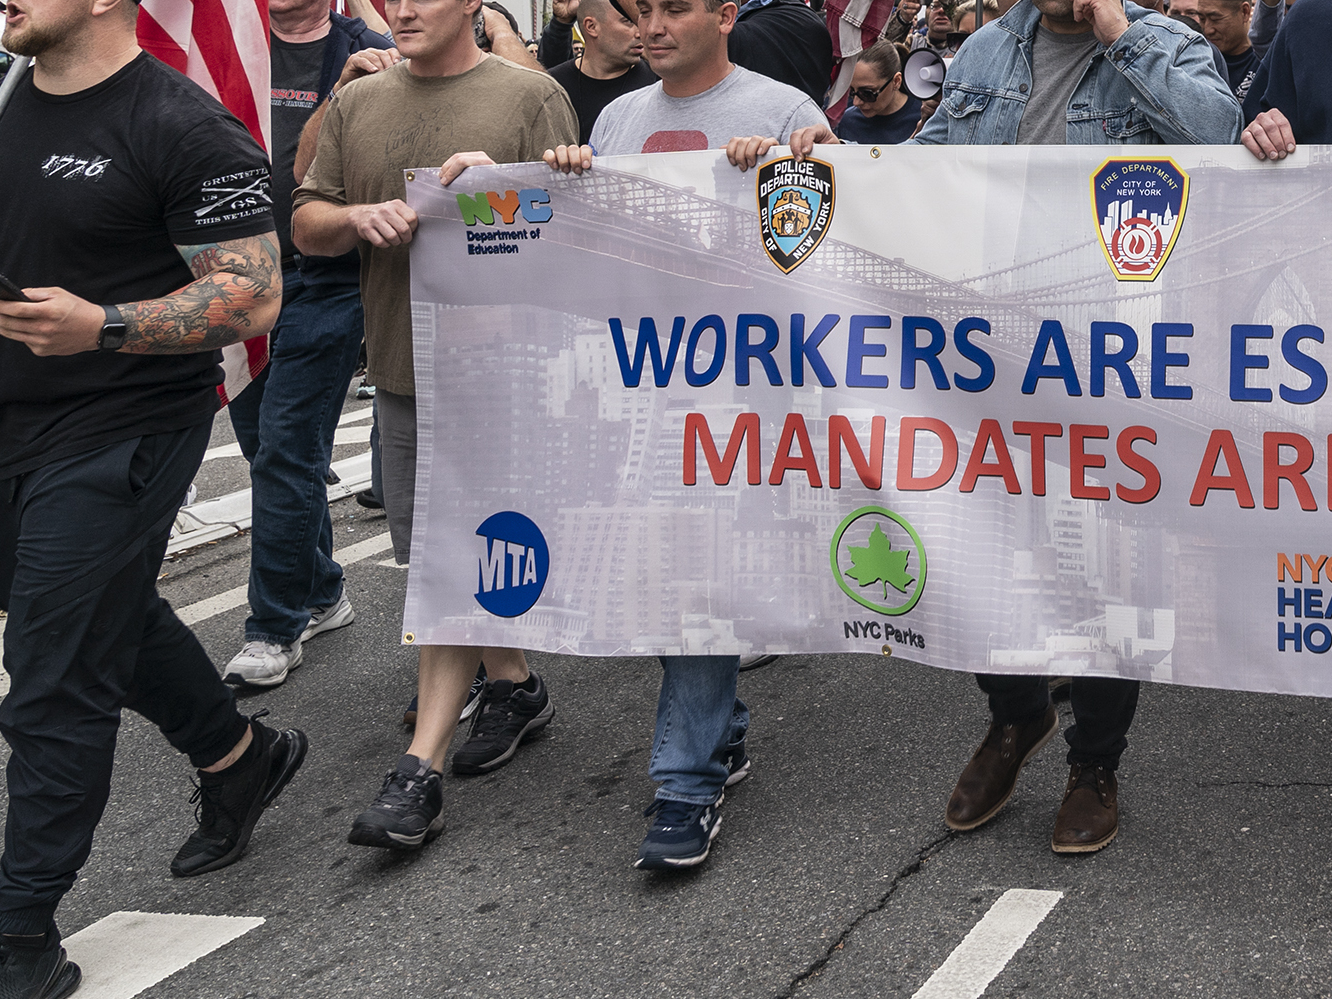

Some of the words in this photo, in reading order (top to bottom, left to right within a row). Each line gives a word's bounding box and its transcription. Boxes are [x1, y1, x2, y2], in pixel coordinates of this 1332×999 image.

[42, 155, 112, 180] 1776
[774, 160, 815, 176] POLICE
[1100, 171, 1119, 191] FIRE
[1121, 163, 1178, 190] DEPARTMENT
[760, 174, 831, 198] DEPARTMENT
[1122, 180, 1142, 188] CITY
[1145, 180, 1157, 188] OF
[202, 194, 218, 202] US
[231, 196, 257, 210] GS
[456, 188, 553, 226] NYC
[195, 216, 221, 226] THIS
[222, 210, 251, 221] WE'LL
[466, 229, 528, 244] Department
[530, 228, 541, 240] of
[761, 207, 769, 235] CITY
[765, 237, 778, 251] OF
[792, 235, 815, 260] NEW
[813, 201, 831, 232] YORK
[467, 242, 519, 255] Education
[607, 312, 996, 393] WORKERS
[1021, 319, 1194, 400] ARE
[682, 412, 1162, 505] MANDATES
[476, 533, 537, 595] MTA
[843, 620, 882, 640] NYC
[884, 622, 926, 649] Parks
